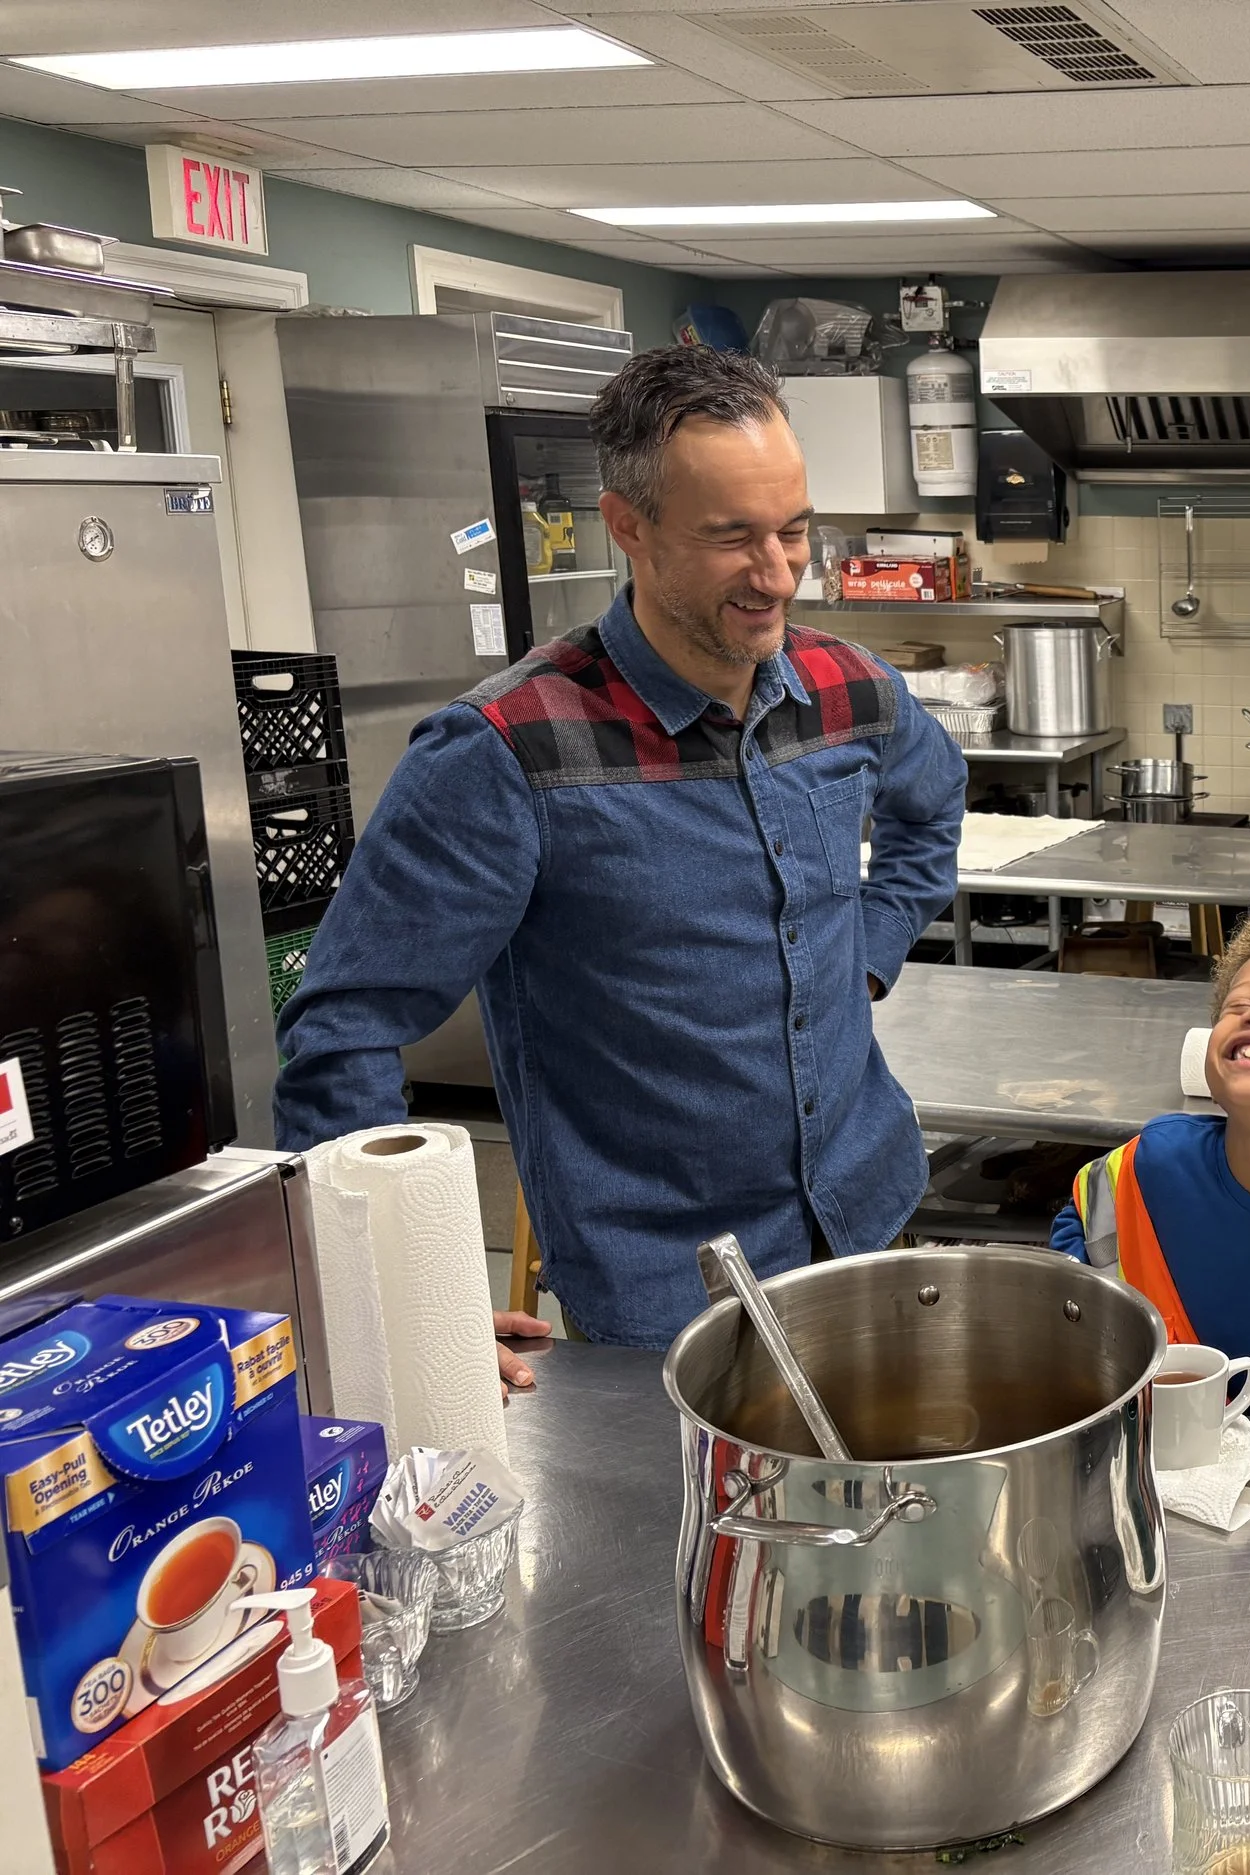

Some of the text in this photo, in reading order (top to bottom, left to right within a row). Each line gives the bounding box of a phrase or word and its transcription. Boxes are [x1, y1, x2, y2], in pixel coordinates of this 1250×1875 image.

[183, 158, 249, 244] EXIT
[847, 580, 867, 589] wrap
[871, 579, 906, 592] pellicule
[133, 1321, 185, 1346] 300
[237, 1335, 290, 1374] Rabat facile
[0, 1340, 76, 1387] etley
[52, 1356, 125, 1396] ORANGE
[248, 1351, 283, 1380] à ouvrir
[126, 1382, 212, 1453] Tetley
[29, 1453, 86, 1495] Easy-Pull
[34, 1469, 87, 1504] Opening
[309, 1471, 344, 1513] tley
[68, 1498, 107, 1524] TEAR HERE
[108, 1461, 254, 1562] ORANGE PEKOE
[441, 1480, 489, 1528] VANILLA
[451, 1517, 465, 1532] BLACK
[463, 1508, 474, 1519] TEA
[455, 1493, 500, 1538] VANILLE
[327, 1519, 362, 1550] PEKOE
[280, 1562, 314, 1591] 945 g
[77, 1669, 126, 1717] 300
[207, 1746, 256, 1808] RE
[216, 1820, 260, 1862] ORANGE
